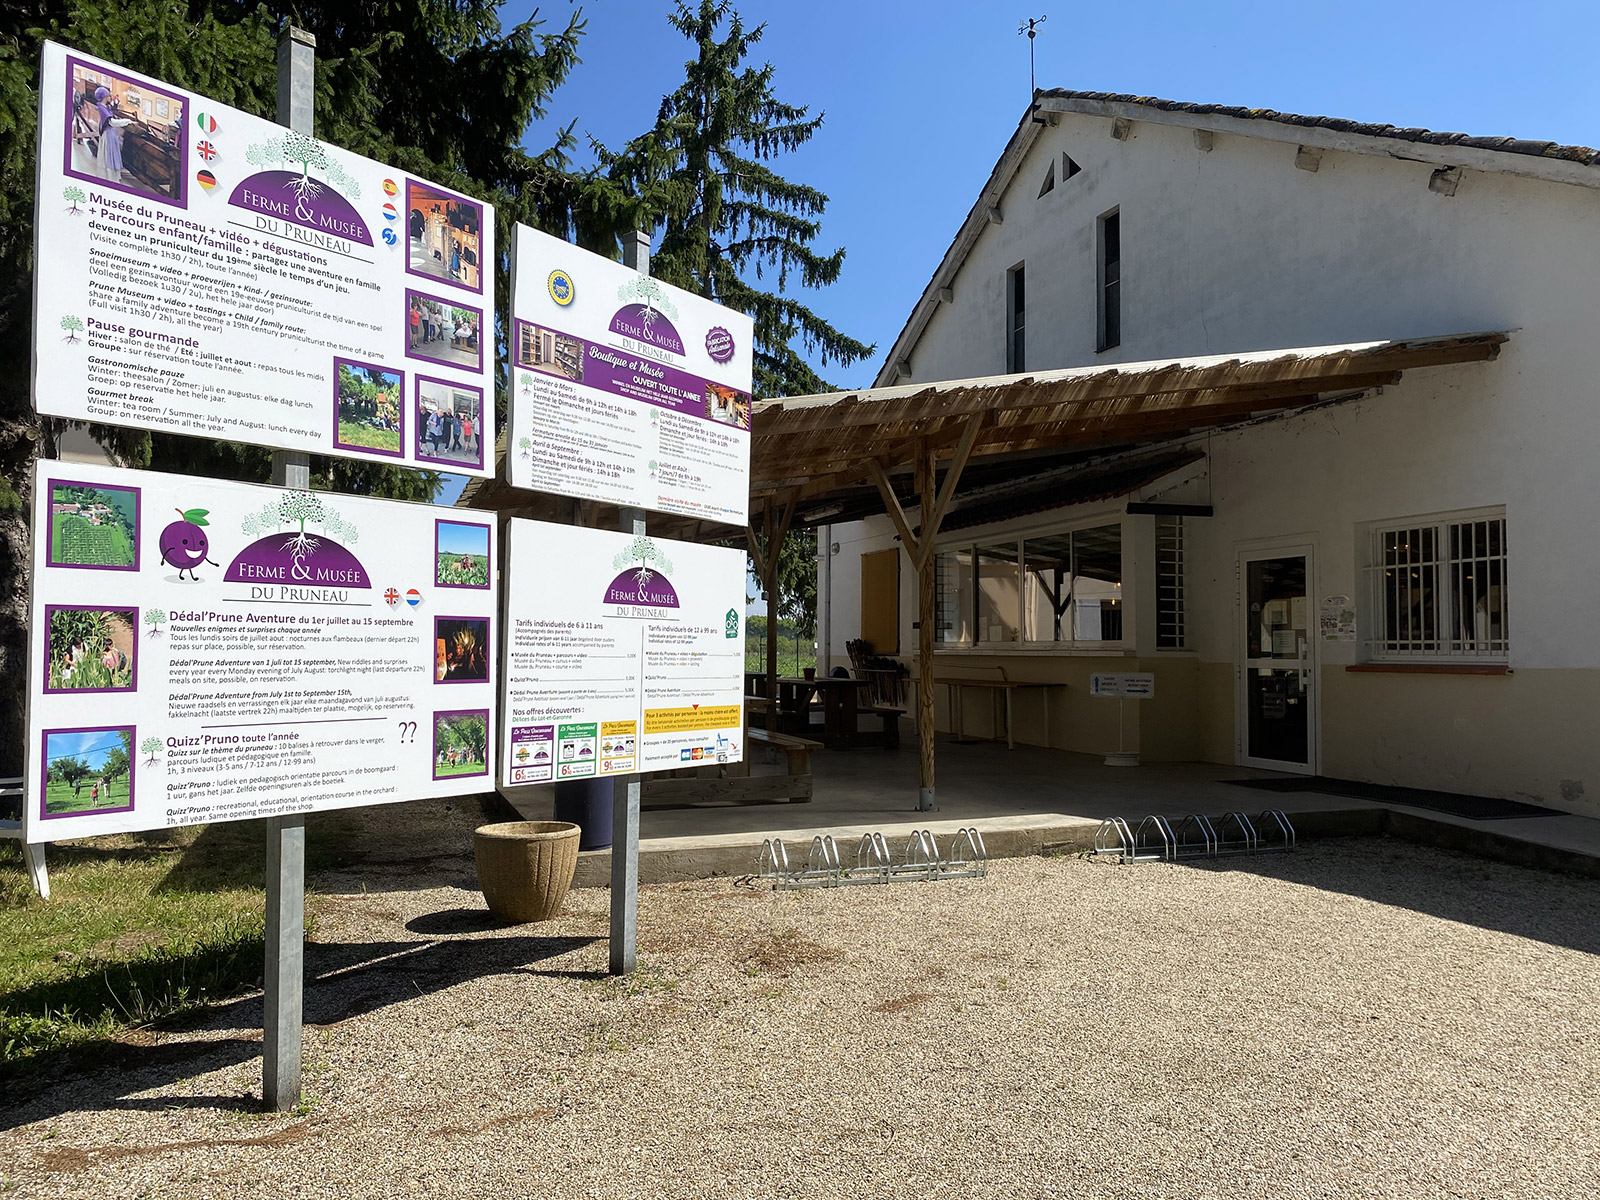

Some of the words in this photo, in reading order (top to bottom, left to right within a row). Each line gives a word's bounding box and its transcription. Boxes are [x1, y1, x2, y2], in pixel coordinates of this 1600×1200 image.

[90, 192, 133, 213] Musée
[137, 206, 152, 218] du
[156, 211, 206, 233] Pruneau
[219, 229, 250, 245] vidéo
[262, 241, 328, 266] dégustations
[243, 189, 290, 218] FERME
[294, 191, 317, 226] &
[320, 212, 363, 240] MUSÉE
[257, 215, 281, 235] DU
[285, 222, 351, 255] PRUNEAU
[88, 220, 131, 238] devenez
[134, 233, 147, 242] un
[150, 237, 209, 258] pruniculteur
[212, 252, 224, 262] du
[253, 263, 278, 276] siècle
[280, 269, 287, 278] le
[289, 272, 315, 285] temps
[316, 279, 334, 290] d'un
[335, 284, 350, 294] jeu.
[101, 208, 155, 232] Parcours
[158, 226, 242, 255] enfant/famille
[252, 252, 288, 267] partagez
[290, 262, 306, 272] une
[308, 267, 343, 282] aventure
[355, 278, 381, 292] famille
[89, 247, 151, 268] Snoeimuseum
[160, 265, 182, 276] video
[190, 273, 236, 289] proeverijen
[243, 285, 263, 295] Kind-
[87, 317, 125, 334] Pause
[129, 328, 199, 350] gourmande
[617, 320, 640, 337] FERME
[643, 320, 655, 343] &
[657, 333, 680, 351] MUSÉE
[88, 339, 121, 352] Groupe
[144, 350, 190, 364] réservation
[192, 359, 213, 369] toute
[88, 330, 112, 341] Hiver
[119, 337, 142, 346] salon
[144, 341, 155, 349] de
[156, 343, 170, 352] thé
[181, 347, 194, 357] Eté
[200, 351, 223, 362] juillet
[234, 359, 252, 368] aout
[258, 364, 278, 372] repas
[279, 367, 294, 376] tous
[296, 369, 306, 378] les
[306, 373, 325, 382] midis
[589, 345, 627, 368] Boutique
[629, 359, 637, 371] et
[639, 361, 664, 380] Musée
[623, 338, 635, 350] DU
[638, 343, 673, 363] PRUNEAU
[88, 355, 158, 374] Gastronomische
[160, 369, 185, 379] pauze
[87, 387, 127, 400] Gourmet
[129, 393, 154, 404] break
[239, 562, 286, 579] FERME
[291, 554, 314, 581] &
[317, 565, 360, 583] MUSÉE
[252, 586, 277, 600] DU
[281, 586, 348, 603] PRUNEAU
[611, 589, 635, 601] FERME
[638, 583, 650, 603] &
[651, 591, 674, 604] MUSÉE
[170, 610, 243, 623] Dédal'Prune
[246, 613, 296, 624] Aventure
[298, 616, 310, 624] du
[312, 616, 325, 625] 1er
[326, 616, 350, 626] juillet
[363, 617, 373, 626] 15
[374, 618, 414, 627] septembre
[617, 607, 629, 616] DU
[633, 607, 668, 618] PRUNEAU
[207, 625, 237, 634] enigmes
[247, 626, 276, 634] surprises
[277, 626, 301, 634] chaque
[526, 707, 544, 716] offres
[545, 707, 581, 715] découvertes
[167, 735, 239, 748] Quizz'Pruno
[242, 734, 266, 743] toute
[268, 731, 299, 741] l'année
